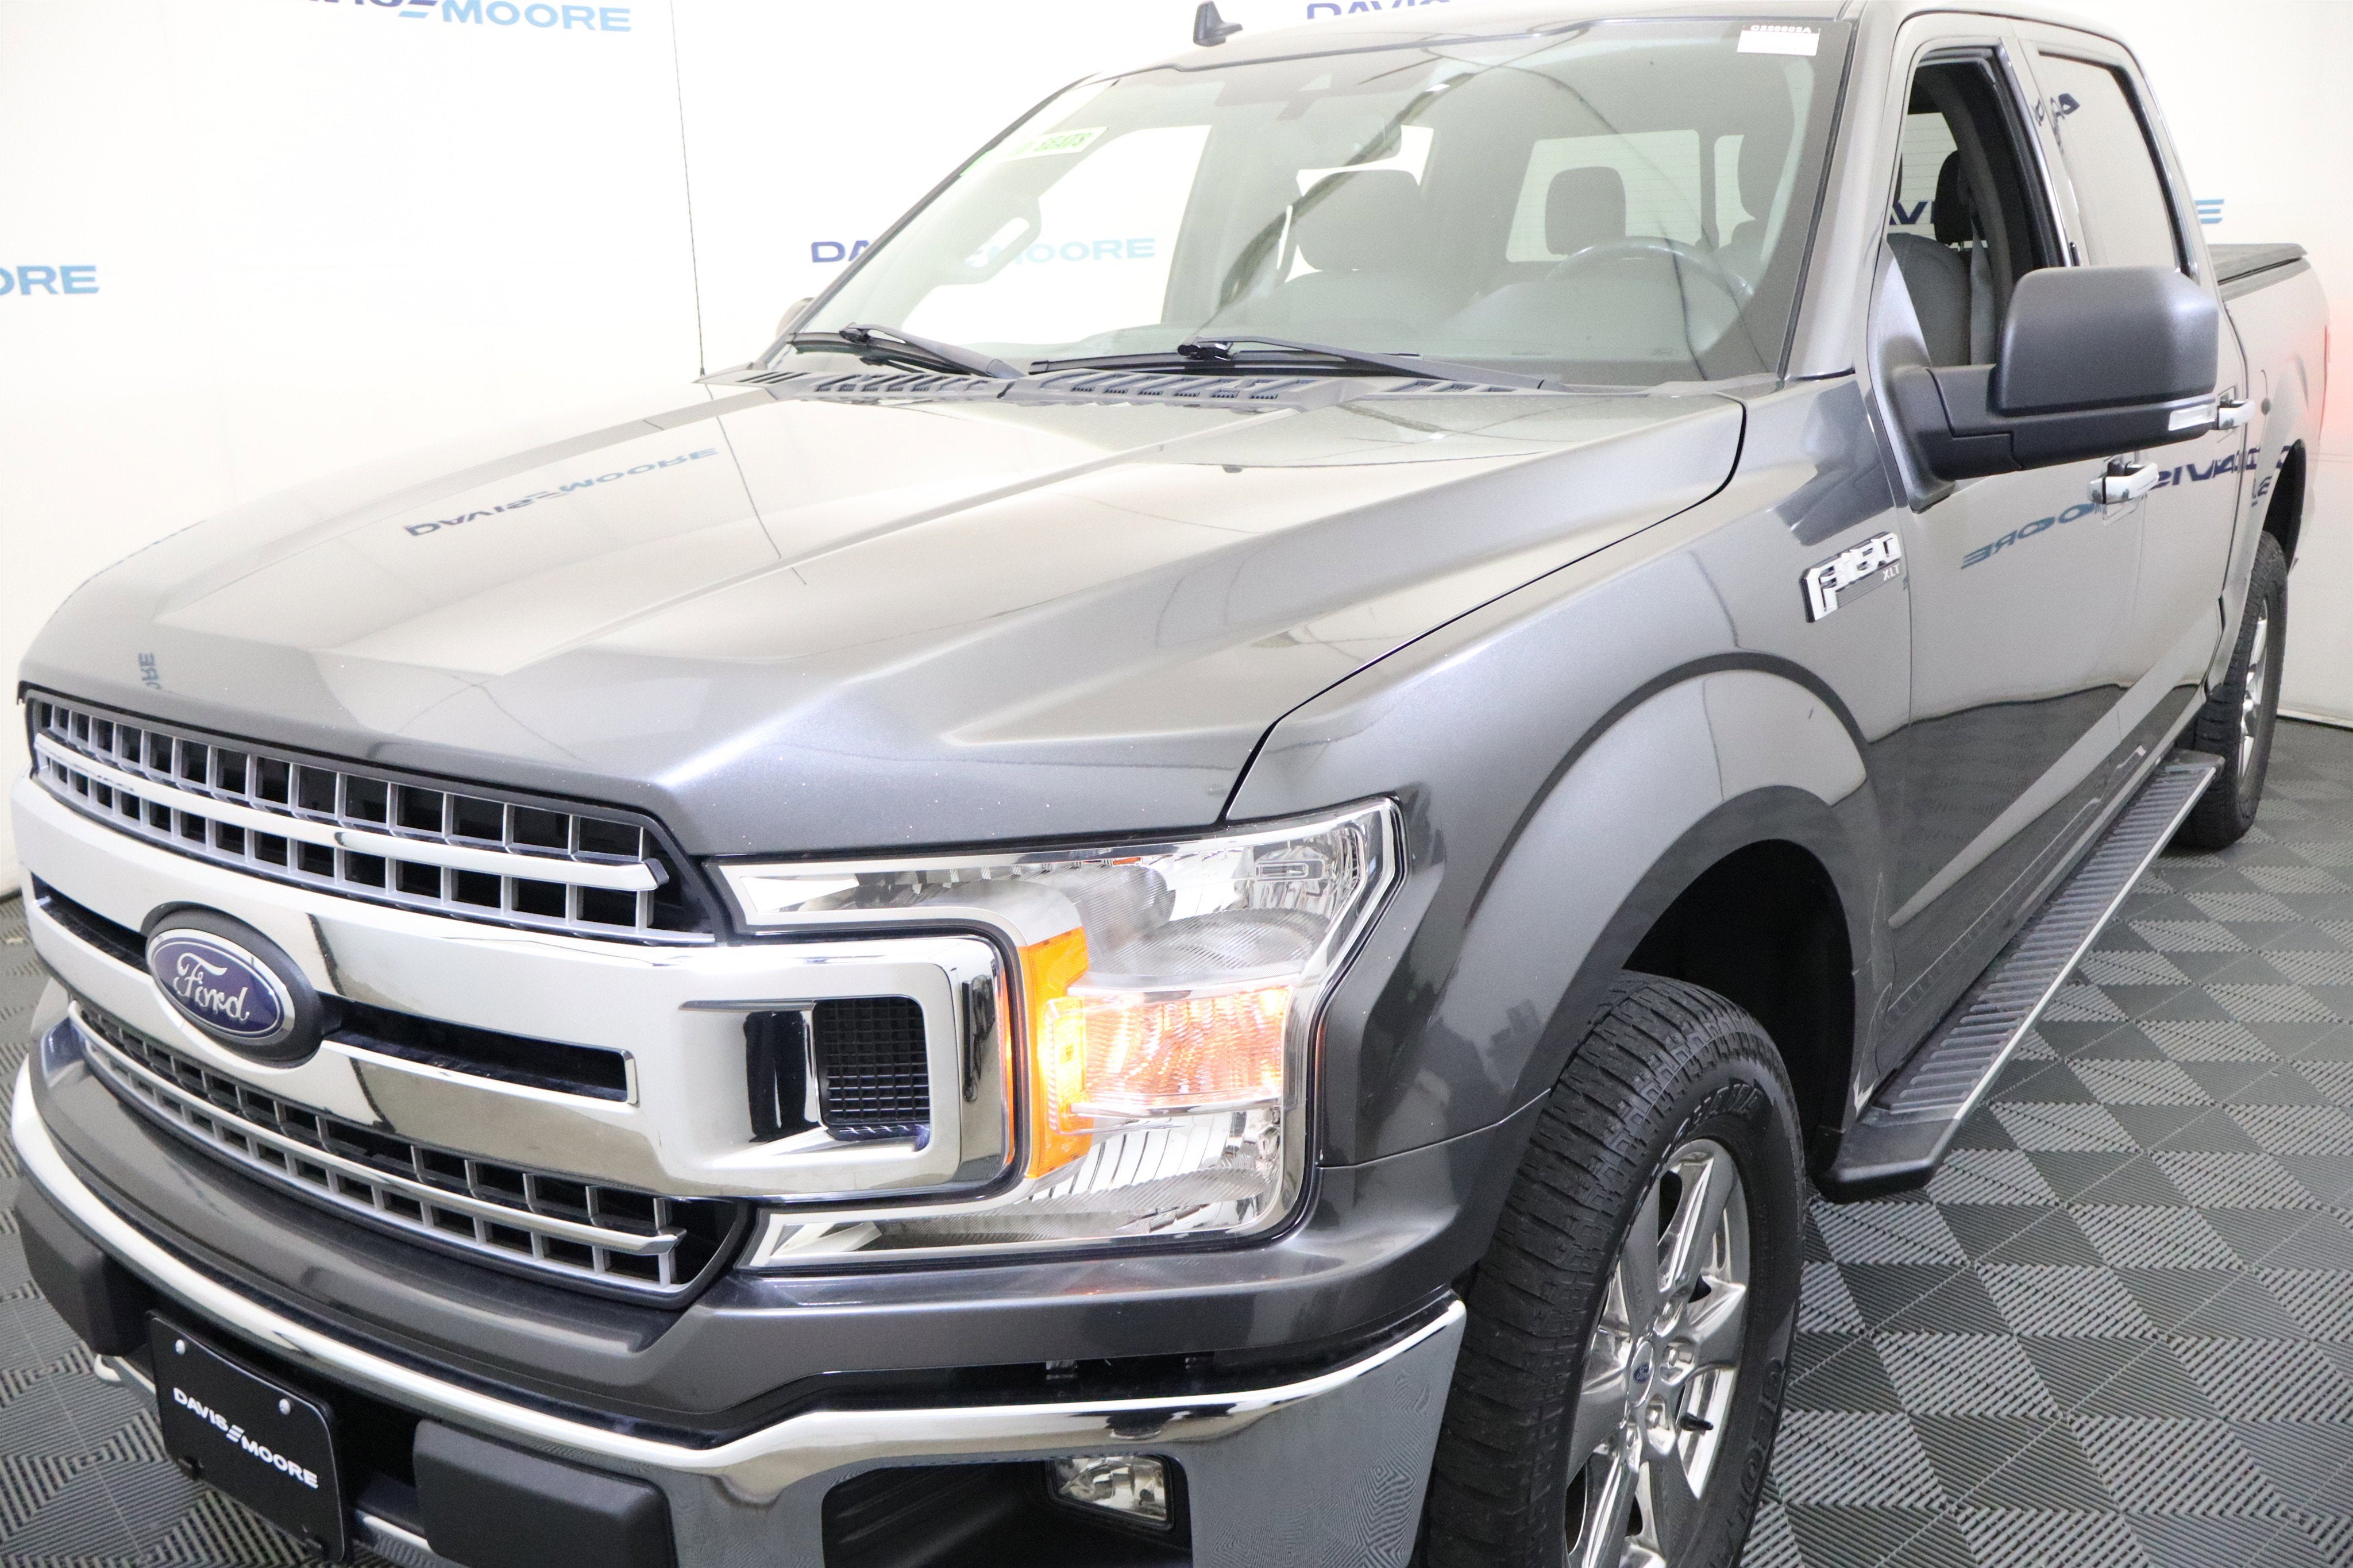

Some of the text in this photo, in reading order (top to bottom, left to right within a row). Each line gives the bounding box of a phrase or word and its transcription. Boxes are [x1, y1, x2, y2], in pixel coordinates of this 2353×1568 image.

[442, 0, 631, 32] MOORE
[1883, 563, 1900, 581] XLT
[173, 952, 250, 1021] Ford
[173, 1387, 319, 1489] DAVIS MOORE
